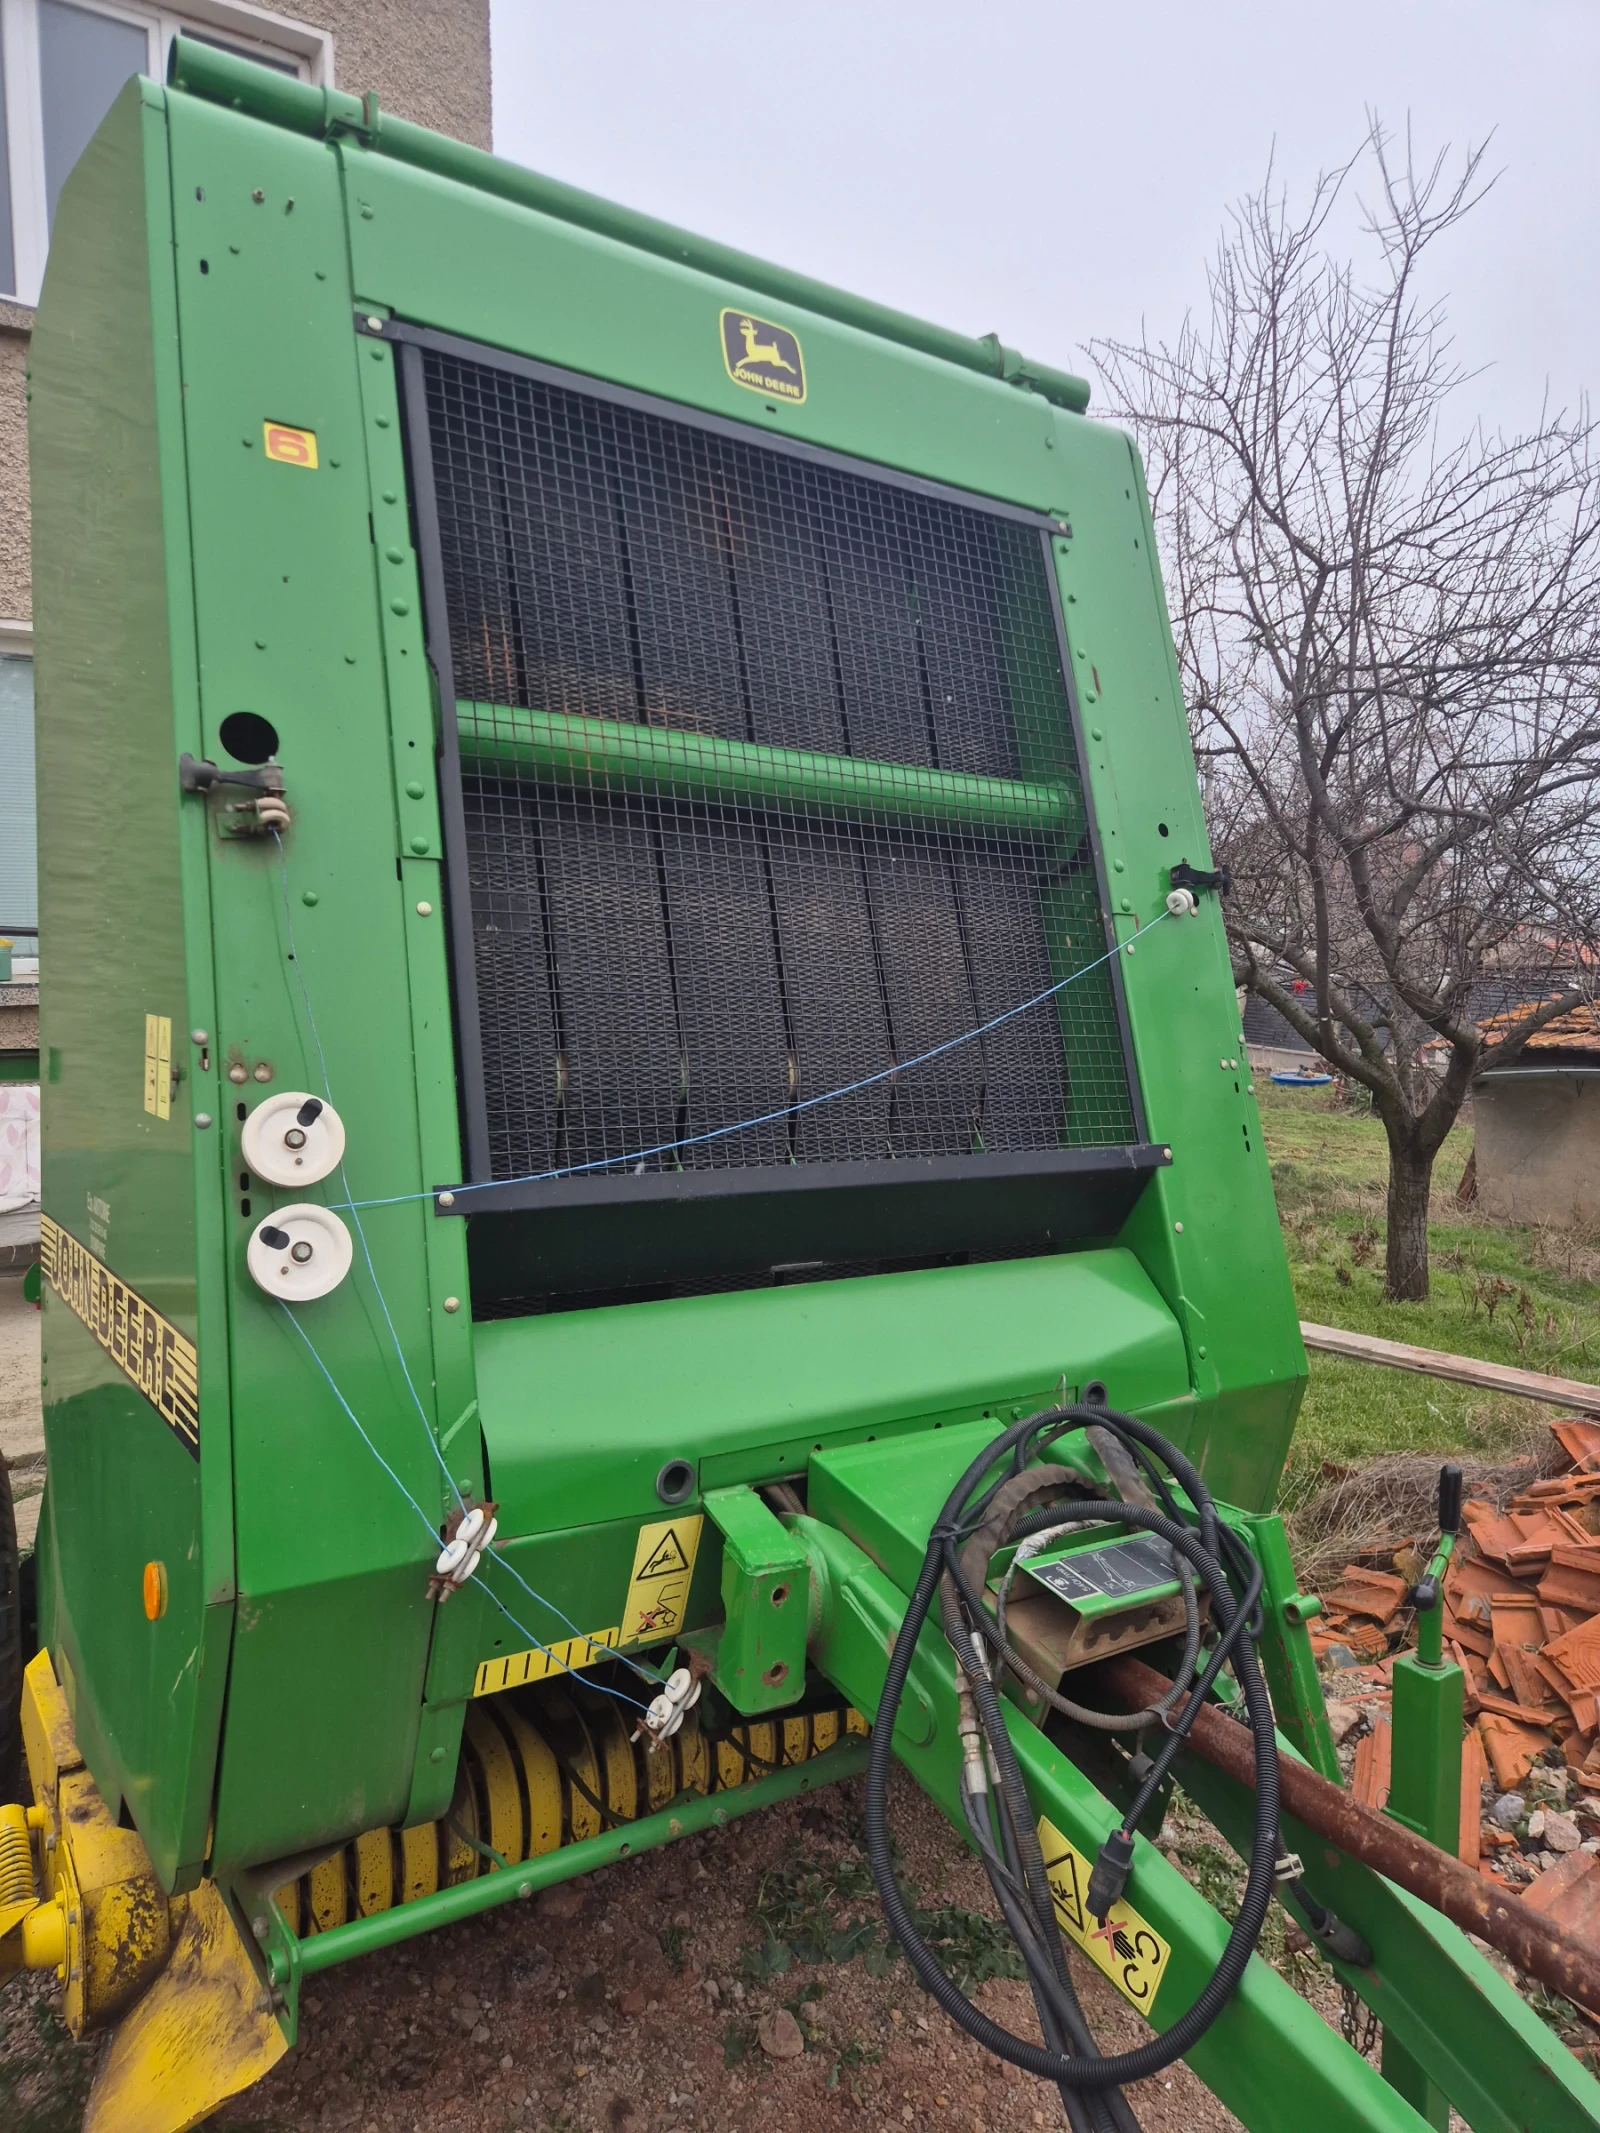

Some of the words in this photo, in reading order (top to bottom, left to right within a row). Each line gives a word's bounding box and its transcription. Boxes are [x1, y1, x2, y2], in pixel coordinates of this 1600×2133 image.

[733, 367, 763, 386] JOHN
[764, 377, 800, 398] DEERE
[268, 428, 309, 463] 6
[51, 1227, 93, 1329] JOHN
[98, 1267, 175, 1416] DEERE
